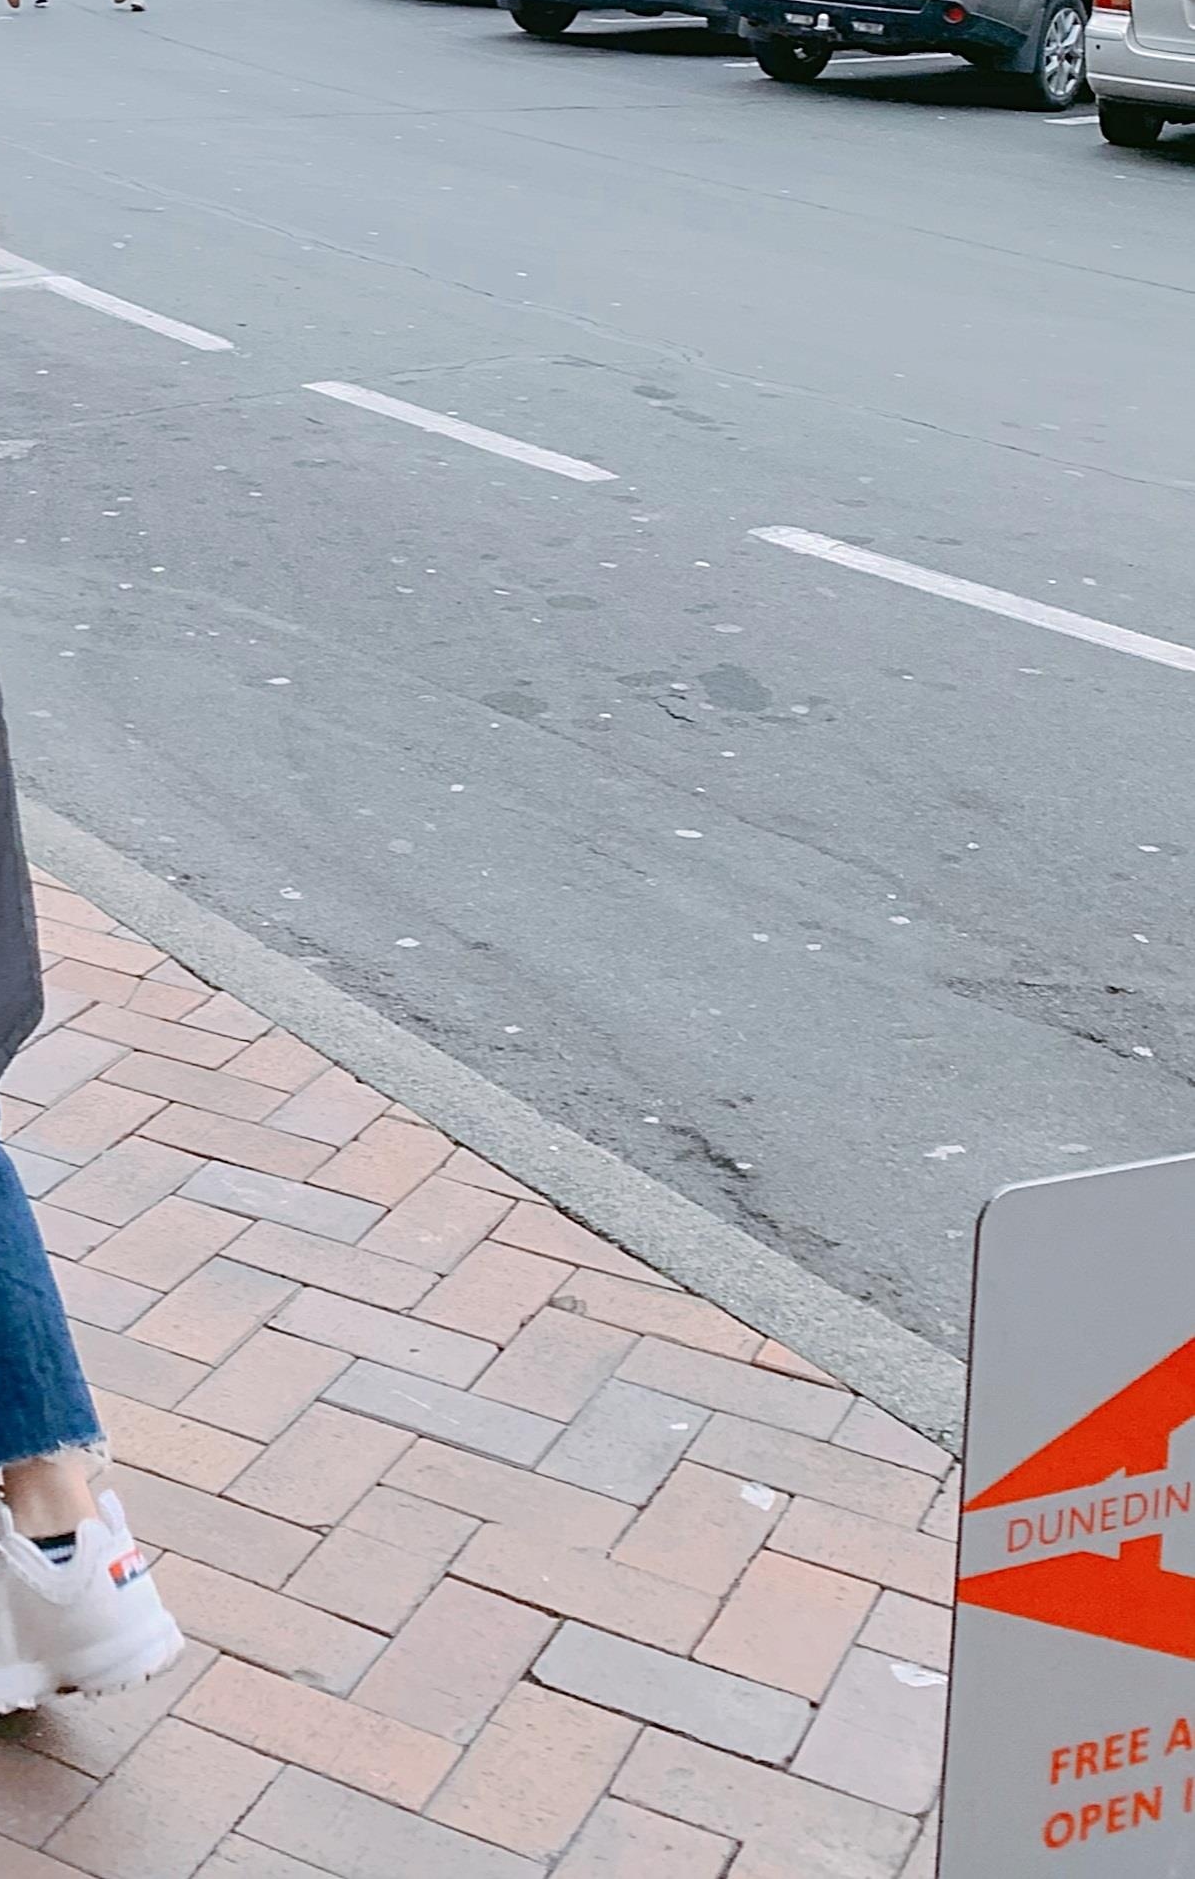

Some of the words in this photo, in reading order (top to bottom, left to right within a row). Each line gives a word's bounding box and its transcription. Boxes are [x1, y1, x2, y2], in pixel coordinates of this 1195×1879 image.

[1007, 1481, 1191, 1553] DUNEDIN
[1050, 1727, 1150, 1786] FREE
[1042, 1786, 1163, 1849] OPEN
